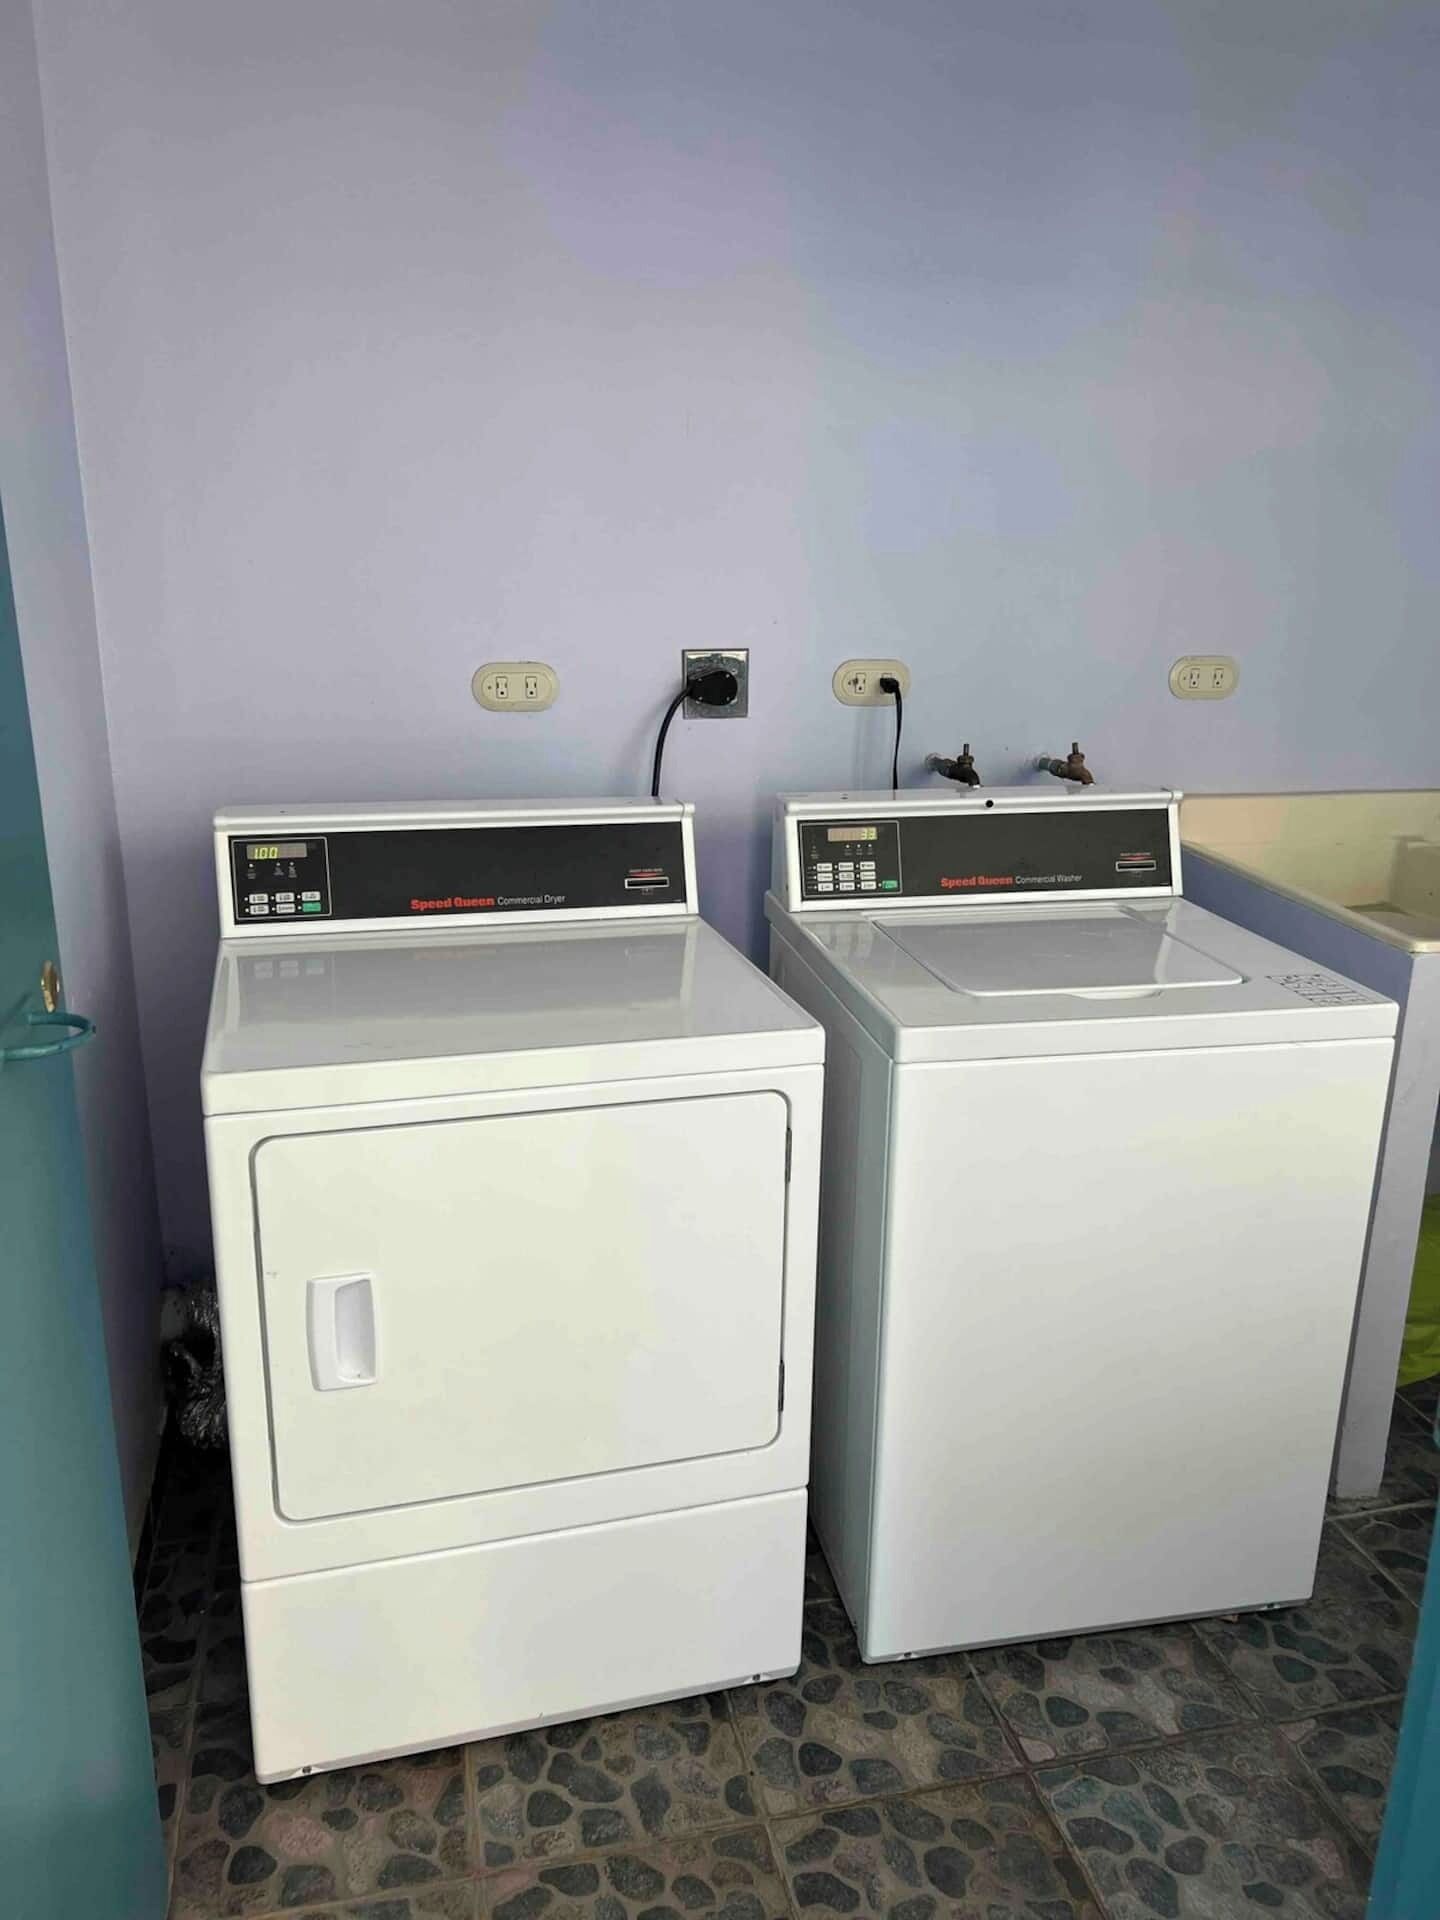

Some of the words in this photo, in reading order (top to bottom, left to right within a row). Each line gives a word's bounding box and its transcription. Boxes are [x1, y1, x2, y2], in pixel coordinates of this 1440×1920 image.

[940, 876, 976, 888] Speed
[978, 875, 1013, 886] Queen
[1015, 875, 1055, 885] Commercial
[1056, 873, 1082, 883] Washer
[411, 898, 452, 911] Speed
[454, 896, 495, 909] Queen
[497, 895, 543, 906] Commercial
[544, 893, 566, 905] Dryer
